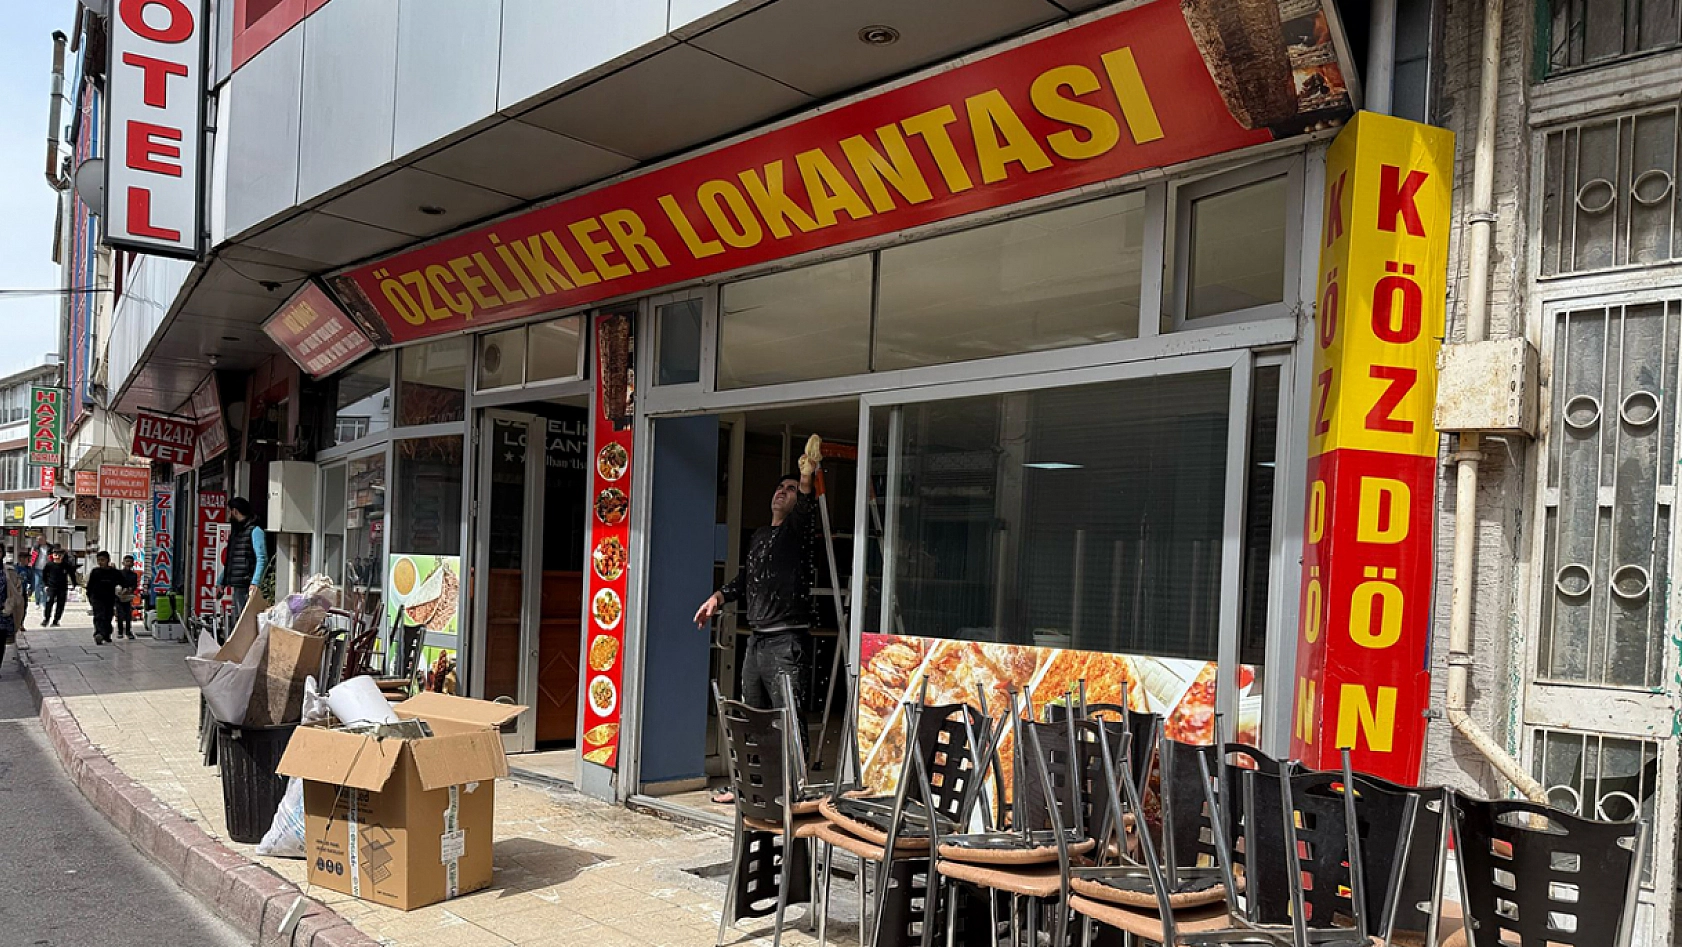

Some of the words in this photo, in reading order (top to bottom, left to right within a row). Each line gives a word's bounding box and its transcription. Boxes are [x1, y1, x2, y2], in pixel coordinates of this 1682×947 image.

[372, 209, 670, 325] ÖZÇELİKLER
[657, 46, 1164, 259] LOKANTASI
[1314, 169, 1348, 436] KÖZ
[1364, 164, 1429, 434] KÖZ
[34, 390, 57, 452] HAZAR
[138, 417, 195, 446] HAZAR
[139, 441, 188, 462] VET
[102, 487, 146, 498] BAYİSİ
[200, 508, 221, 618] VETERİNE
